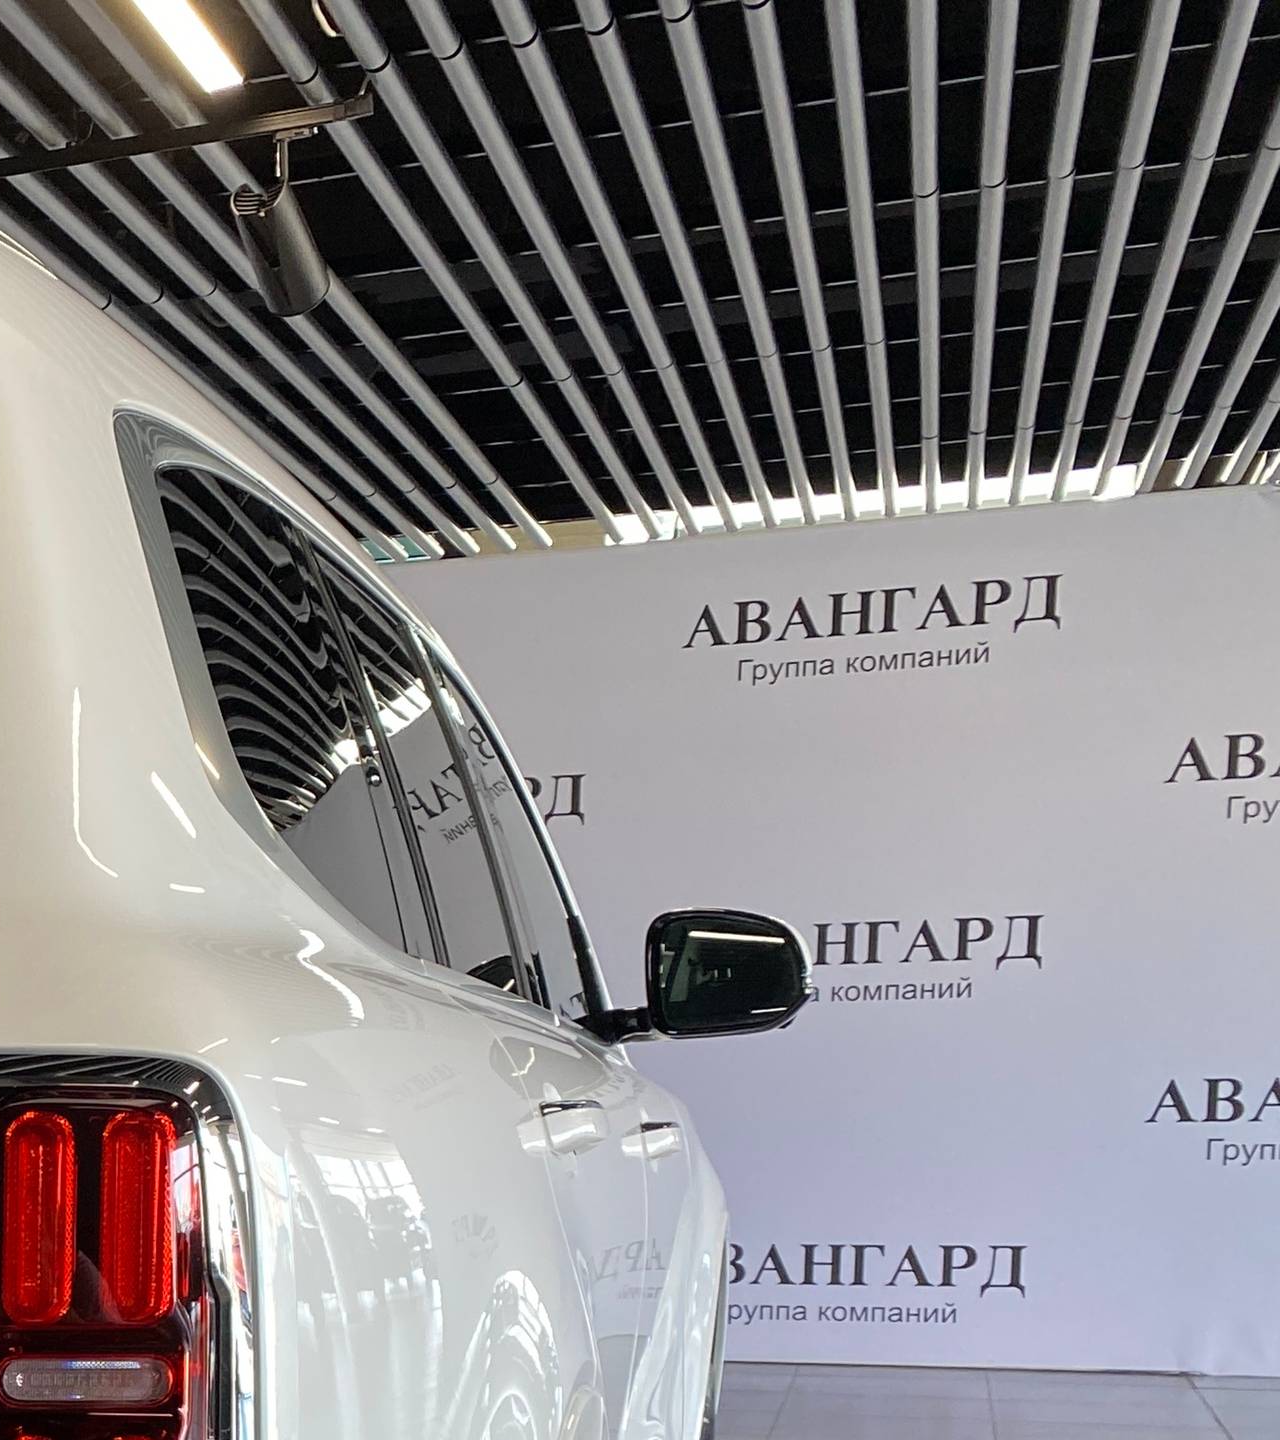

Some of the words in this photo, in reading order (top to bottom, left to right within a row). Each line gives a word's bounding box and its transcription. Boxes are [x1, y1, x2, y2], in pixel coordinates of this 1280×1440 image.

[682, 573, 1064, 649] АВАНГАРД
[737, 656, 836, 686] Группа
[845, 641, 991, 675] компаний
[1163, 733, 1280, 784] АВ
[831, 976, 973, 1002] компаний
[1206, 1138, 1280, 1166] Груп
[818, 1303, 958, 1324] компаний
